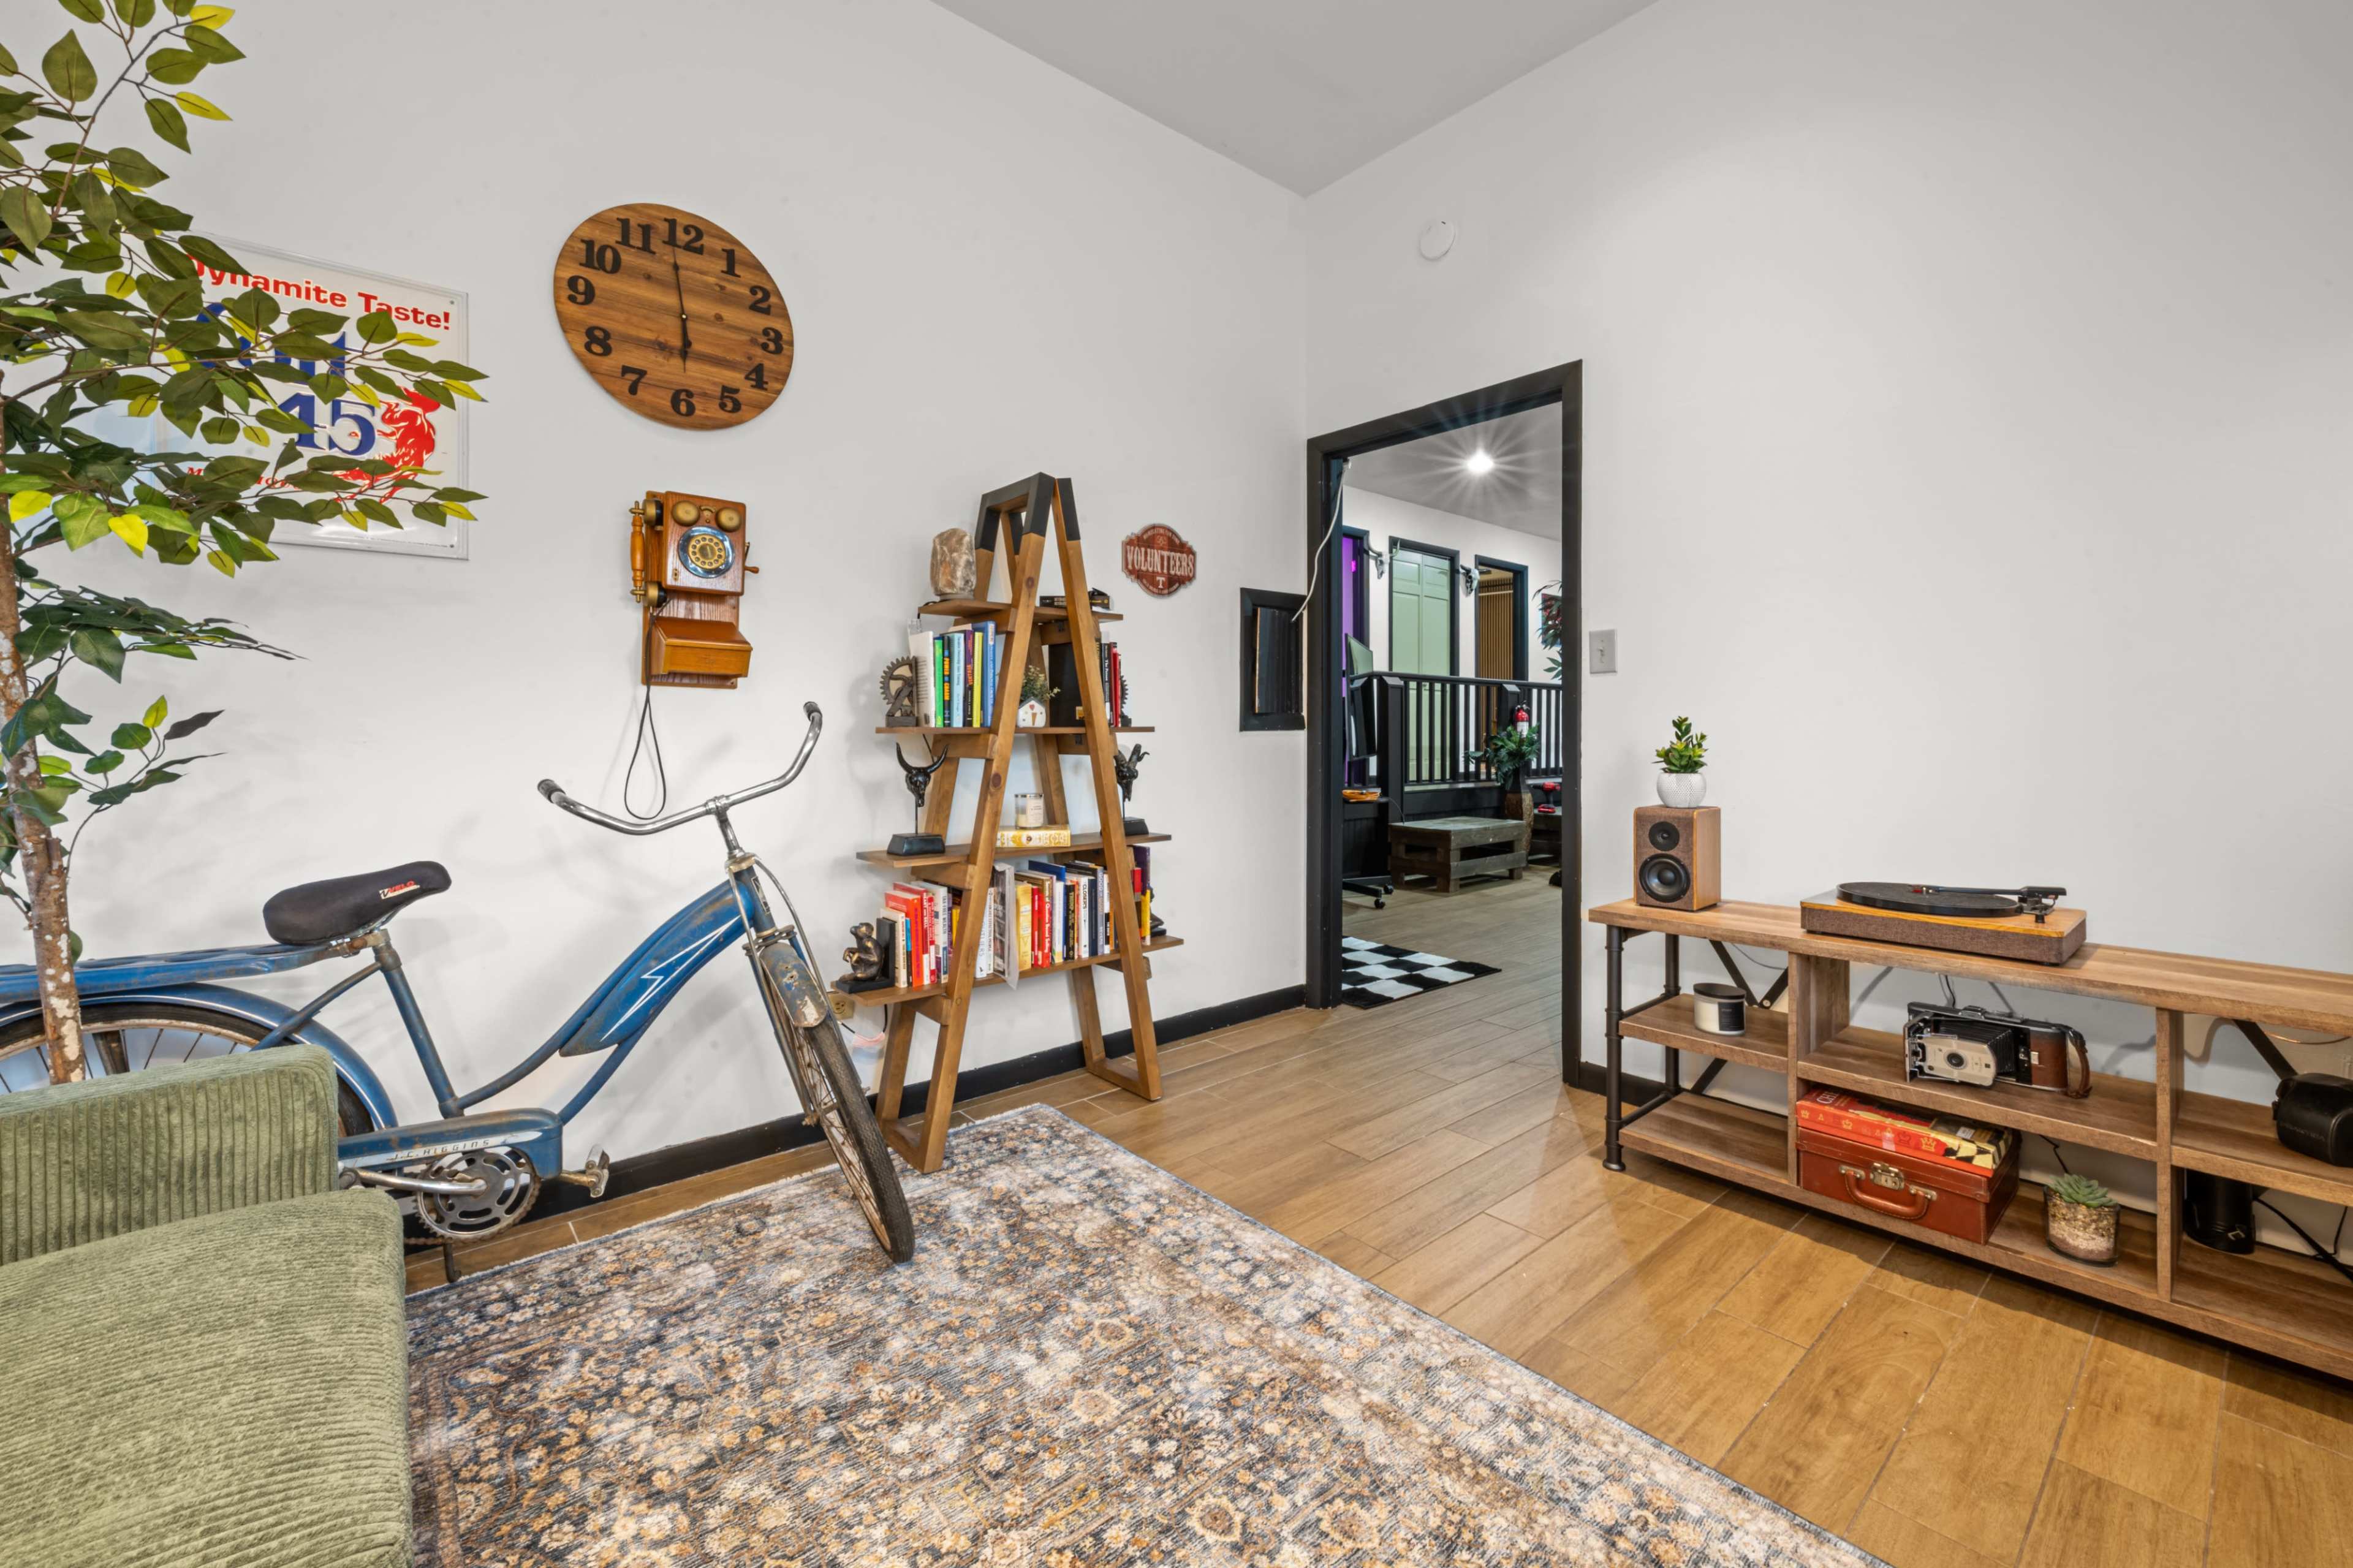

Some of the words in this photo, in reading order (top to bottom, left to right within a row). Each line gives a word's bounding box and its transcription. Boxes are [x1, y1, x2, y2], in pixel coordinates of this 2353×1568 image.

[615, 218, 656, 255] 11
[662, 218, 704, 255] 12
[579, 238, 621, 274] 10
[721, 248, 741, 278] 1
[567, 275, 596, 305] 9
[748, 285, 771, 316] 2
[584, 326, 612, 357] 8
[760, 327, 784, 355] 3
[620, 365, 647, 396] 7
[744, 363, 769, 391] 4
[670, 388, 696, 417] 6
[718, 385, 741, 413] 5
[1126, 545, 1194, 578] VOLUNTEERS
[1156, 577, 1165, 588] T
[423, 1139, 490, 1156] HIGGINS
